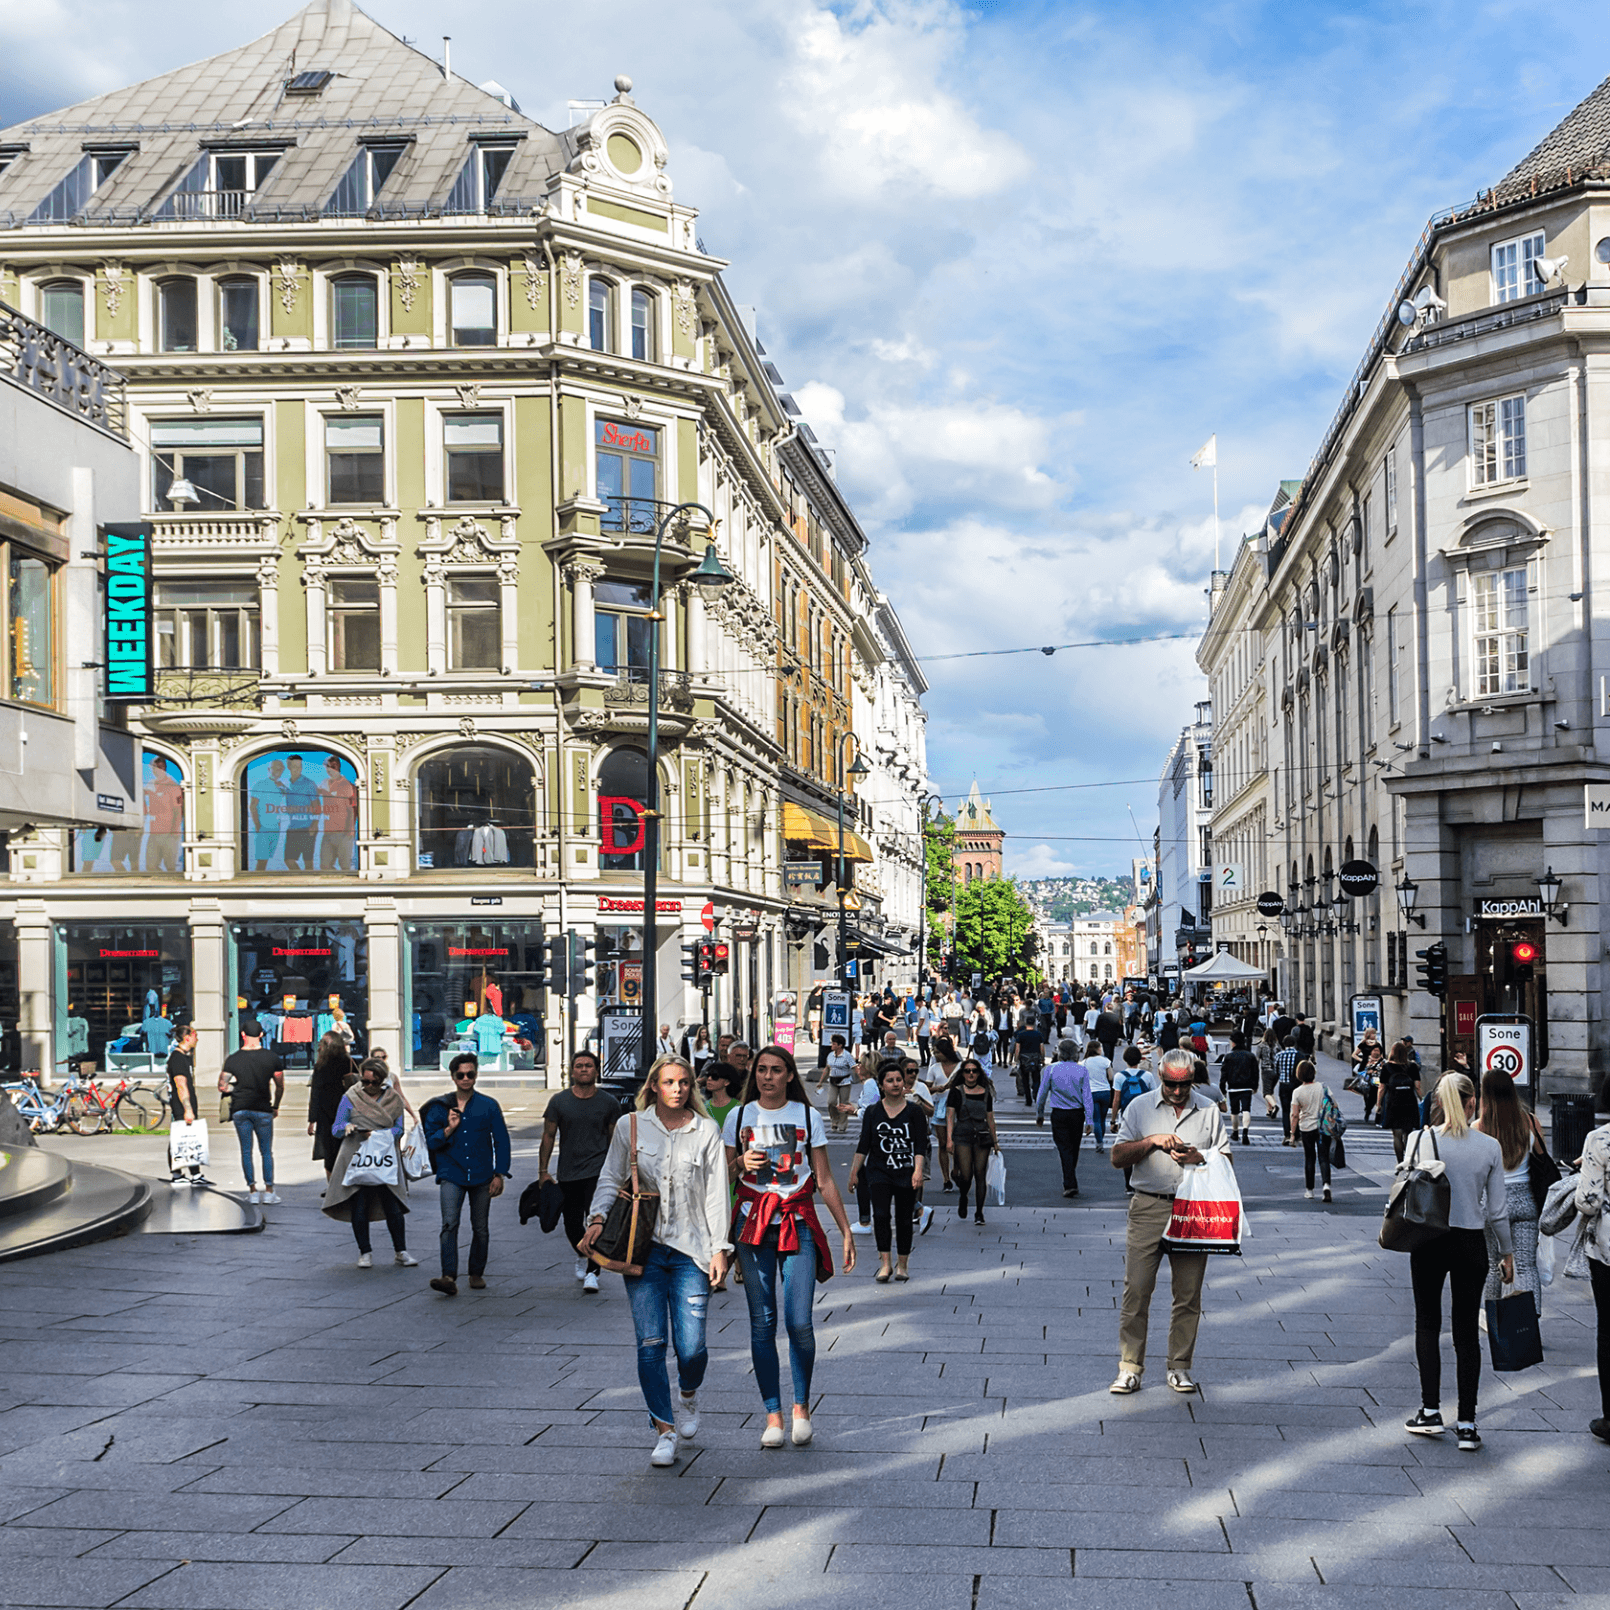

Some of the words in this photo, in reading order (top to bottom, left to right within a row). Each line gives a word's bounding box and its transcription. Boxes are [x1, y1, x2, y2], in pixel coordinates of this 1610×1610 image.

[1223, 867, 1236, 885] 2
[1341, 874, 1376, 882] KappAhl
[1481, 899, 1540, 915] KappAhl
[1459, 1013, 1474, 1021] SALE
[1489, 1028, 1520, 1039] Sone
[1493, 1054, 1516, 1071] 30
